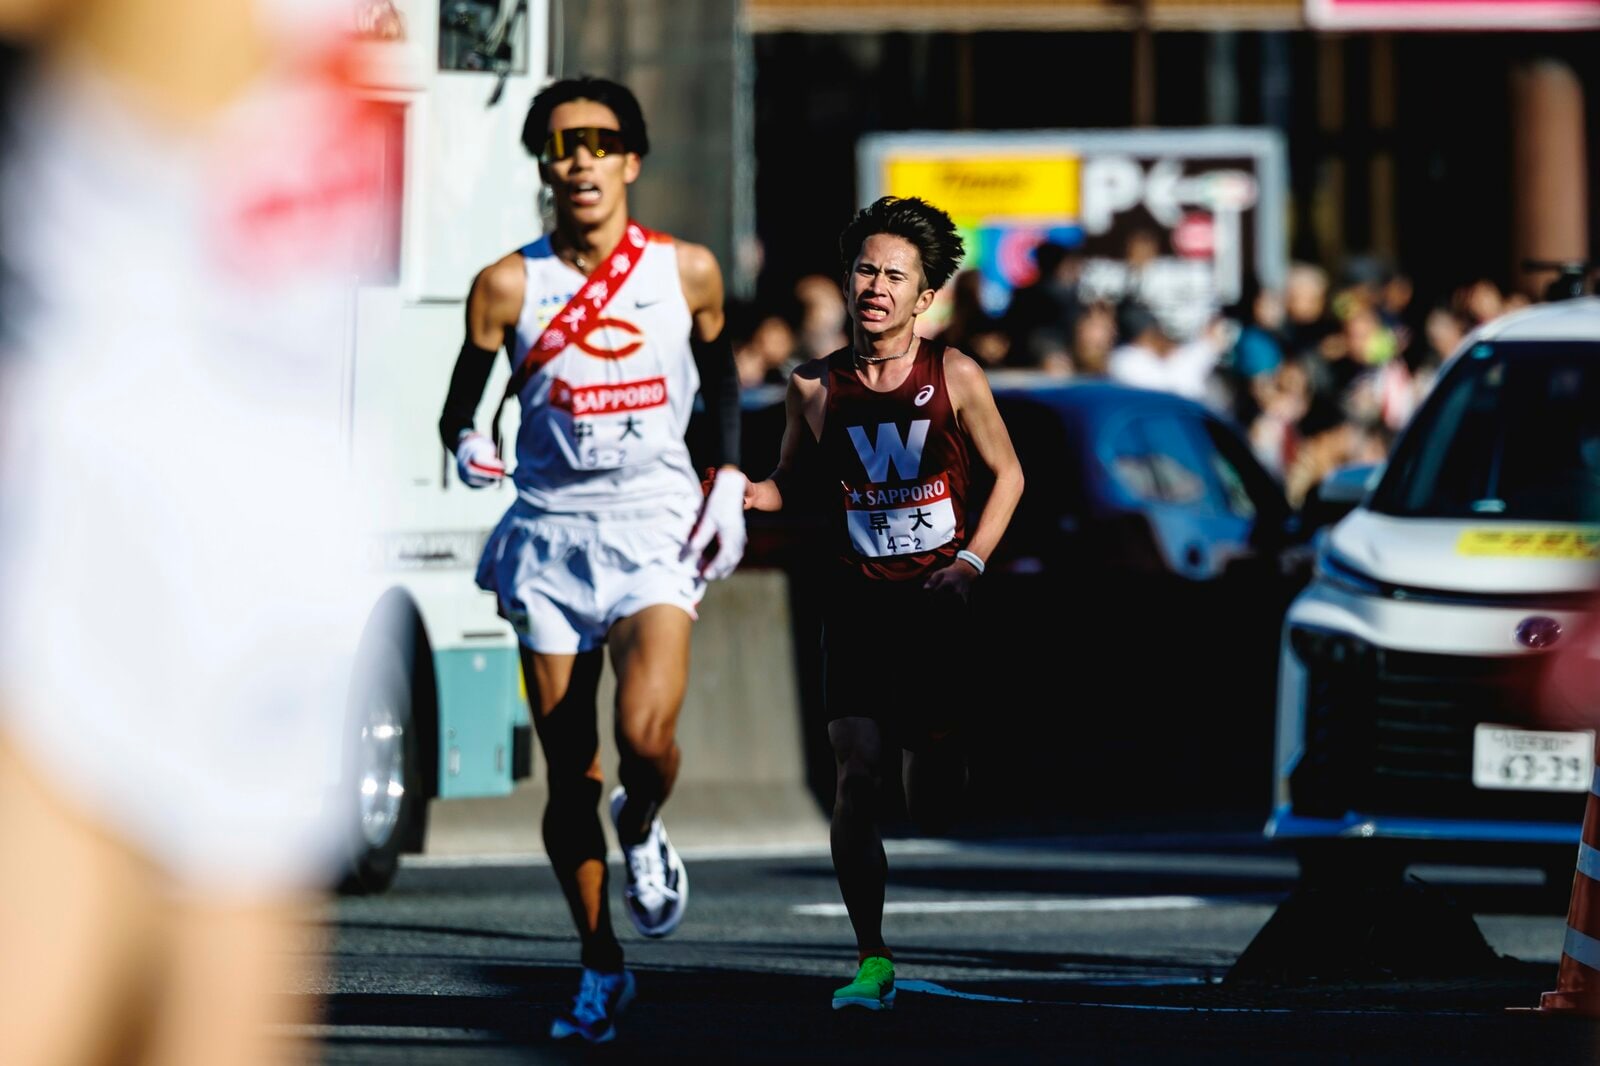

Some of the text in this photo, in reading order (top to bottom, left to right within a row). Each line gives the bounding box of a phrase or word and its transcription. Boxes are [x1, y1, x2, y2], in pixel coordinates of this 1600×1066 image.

[572, 383, 665, 413] SAPPORO
[846, 419, 931, 483] W
[866, 480, 945, 506] SAPPORO
[887, 536, 923, 553] 4-2
